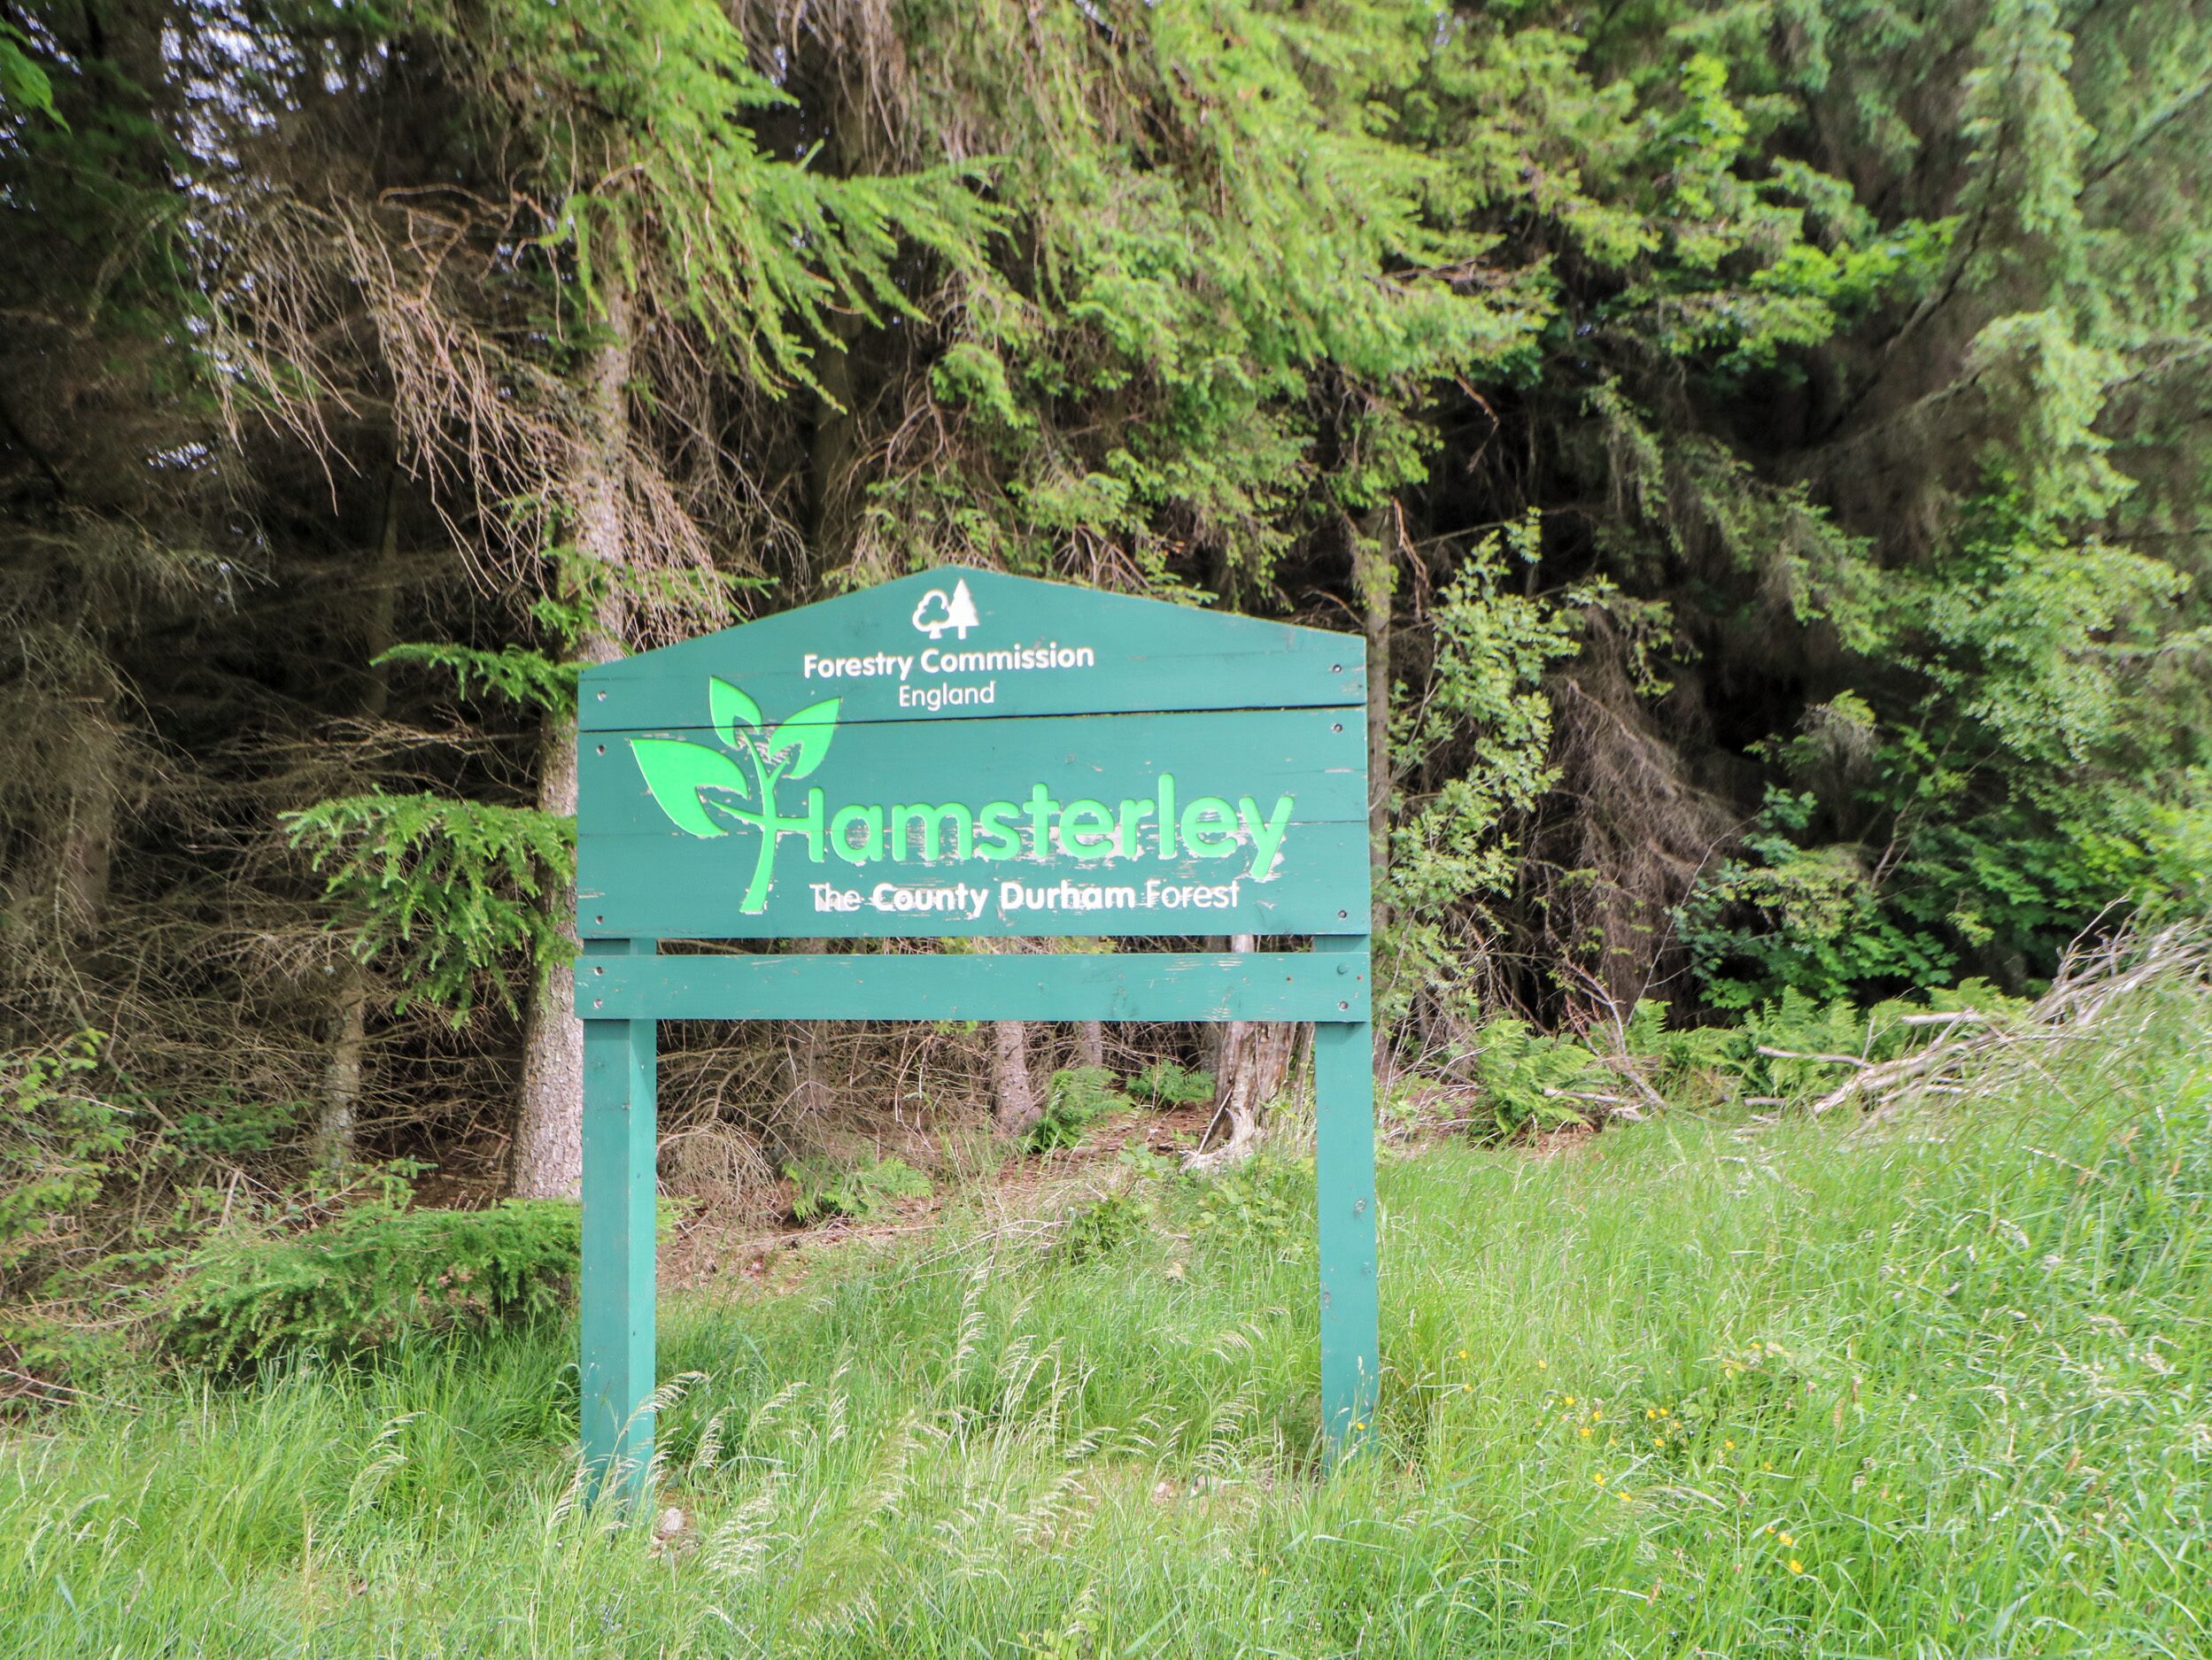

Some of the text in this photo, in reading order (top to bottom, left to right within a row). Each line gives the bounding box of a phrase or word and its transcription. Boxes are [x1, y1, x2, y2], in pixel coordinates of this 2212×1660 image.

[803, 641, 1094, 681] Forestry Commission
[899, 680, 996, 711] England
[710, 729, 1295, 915] Hamsterley
[809, 879, 1240, 919] The County Durham Forest
